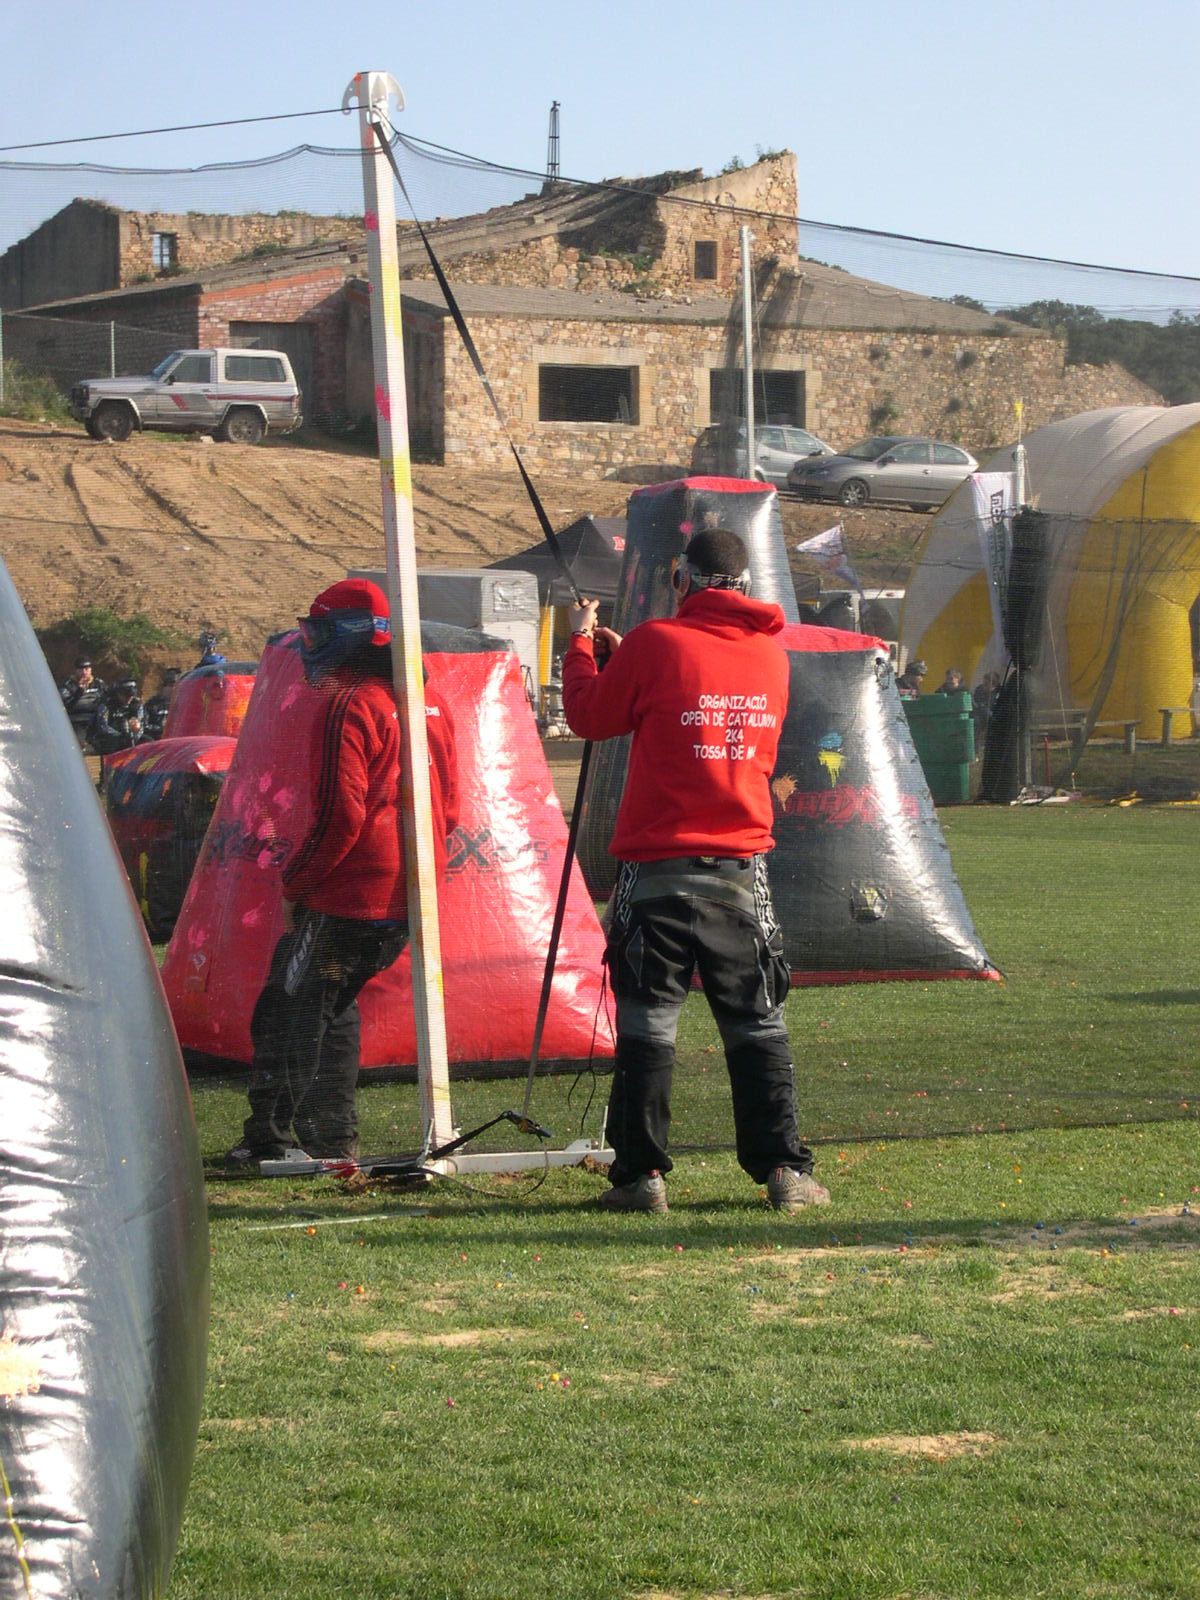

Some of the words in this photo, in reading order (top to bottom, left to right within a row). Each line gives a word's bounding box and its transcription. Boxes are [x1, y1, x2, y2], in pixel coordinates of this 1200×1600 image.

[698, 694, 767, 710] ORGANIZACIÓ
[680, 711, 709, 726] OPEN
[712, 711, 725, 727] DE
[727, 712, 776, 729] CATALUNYA
[725, 728, 744, 743] 2K4
[693, 744, 727, 760] TOSSA
[730, 745, 745, 760] DE
